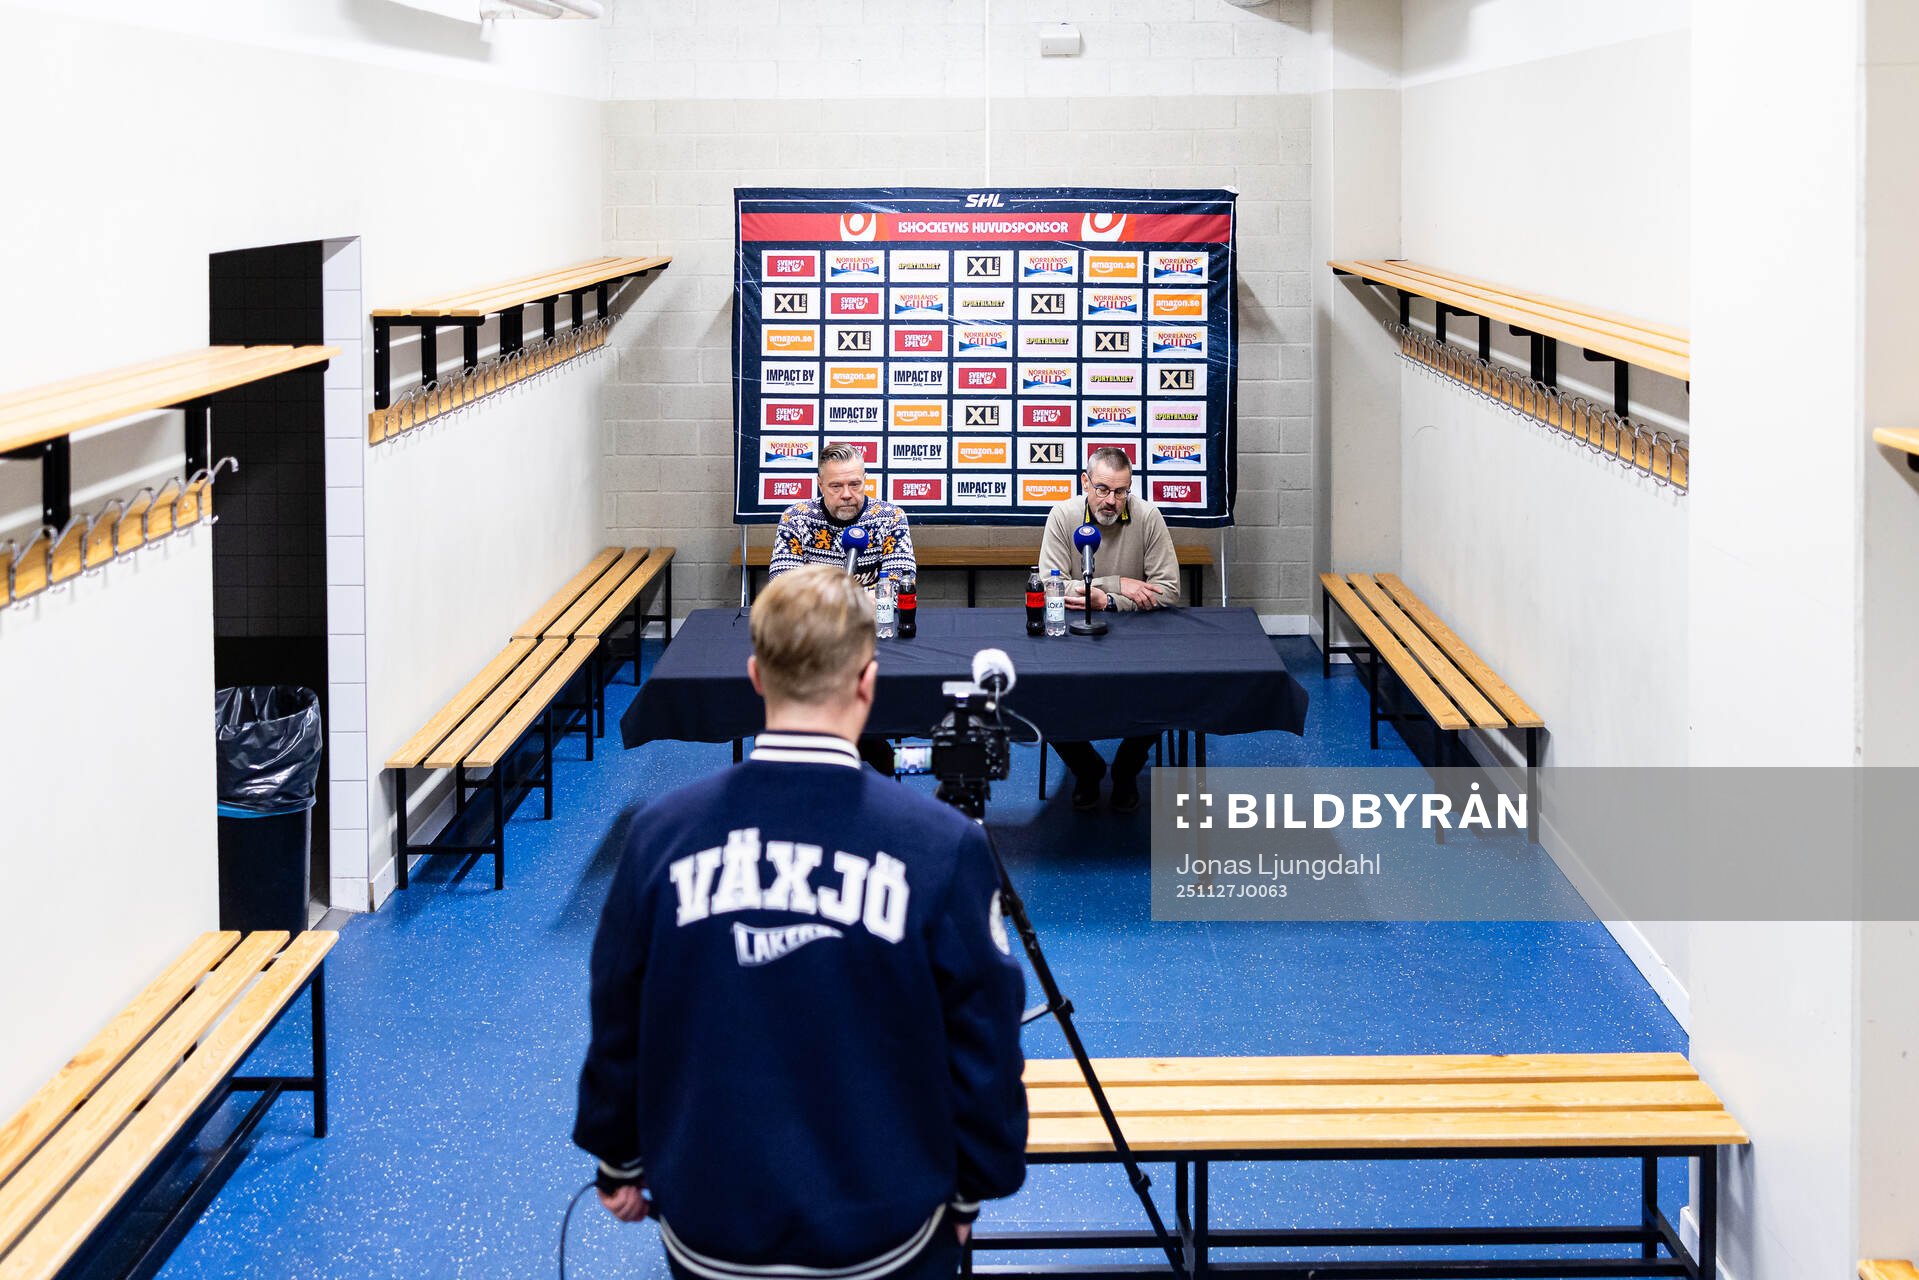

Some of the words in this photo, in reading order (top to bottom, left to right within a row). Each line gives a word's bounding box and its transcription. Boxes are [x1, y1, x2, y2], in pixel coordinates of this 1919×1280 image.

[965, 193, 1005, 208] SHL
[898, 221, 969, 234] ISHOCKEYNS
[972, 221, 1068, 234] HUVUDSPONSOR
[1030, 257, 1068, 265] NORRLANDS
[1160, 258, 1198, 266] NORRLANDS
[840, 263, 870, 271] GULD
[968, 258, 999, 275] XL
[1034, 263, 1064, 271] GULD
[1092, 262, 1136, 270] amazon.se
[1164, 264, 1194, 272] GULD
[900, 294, 938, 302] NORRLANDS
[1094, 295, 1132, 303] NORRLANDS
[776, 295, 807, 312] XL
[905, 300, 934, 308] GULD
[1033, 295, 1063, 313] XL
[1098, 301, 1128, 309] GULD
[1156, 300, 1200, 308] amazon.se
[769, 335, 813, 343] amazon.se
[840, 332, 870, 350] XL
[968, 338, 998, 346] GULD
[1097, 333, 1127, 351] XL
[1163, 339, 1192, 347] GULD
[766, 370, 800, 381] IMPACT
[802, 370, 814, 381] BY
[833, 372, 877, 381] amazon.se
[894, 370, 928, 382] IMPACT
[930, 370, 942, 382] BY
[1033, 375, 1062, 383] GULD
[1162, 371, 1192, 389] XL
[830, 407, 863, 419] IMPACT
[866, 407, 878, 419] BY
[896, 410, 940, 418] amazon.se
[967, 407, 997, 424] XL
[1097, 413, 1127, 421] GULD
[770, 442, 809, 450] NORRLANDS
[1158, 445, 1196, 453] NORRLANDS
[775, 448, 805, 456] GULD
[893, 445, 926, 457] IMPACT
[929, 445, 942, 457] BY
[960, 448, 1004, 456] amazon.se
[1032, 444, 1062, 462] XL
[957, 482, 990, 494] IMPACT
[993, 482, 1006, 494] BY
[1025, 485, 1069, 493] amazon.se
[670, 827, 910, 944] VÄXJÖ
